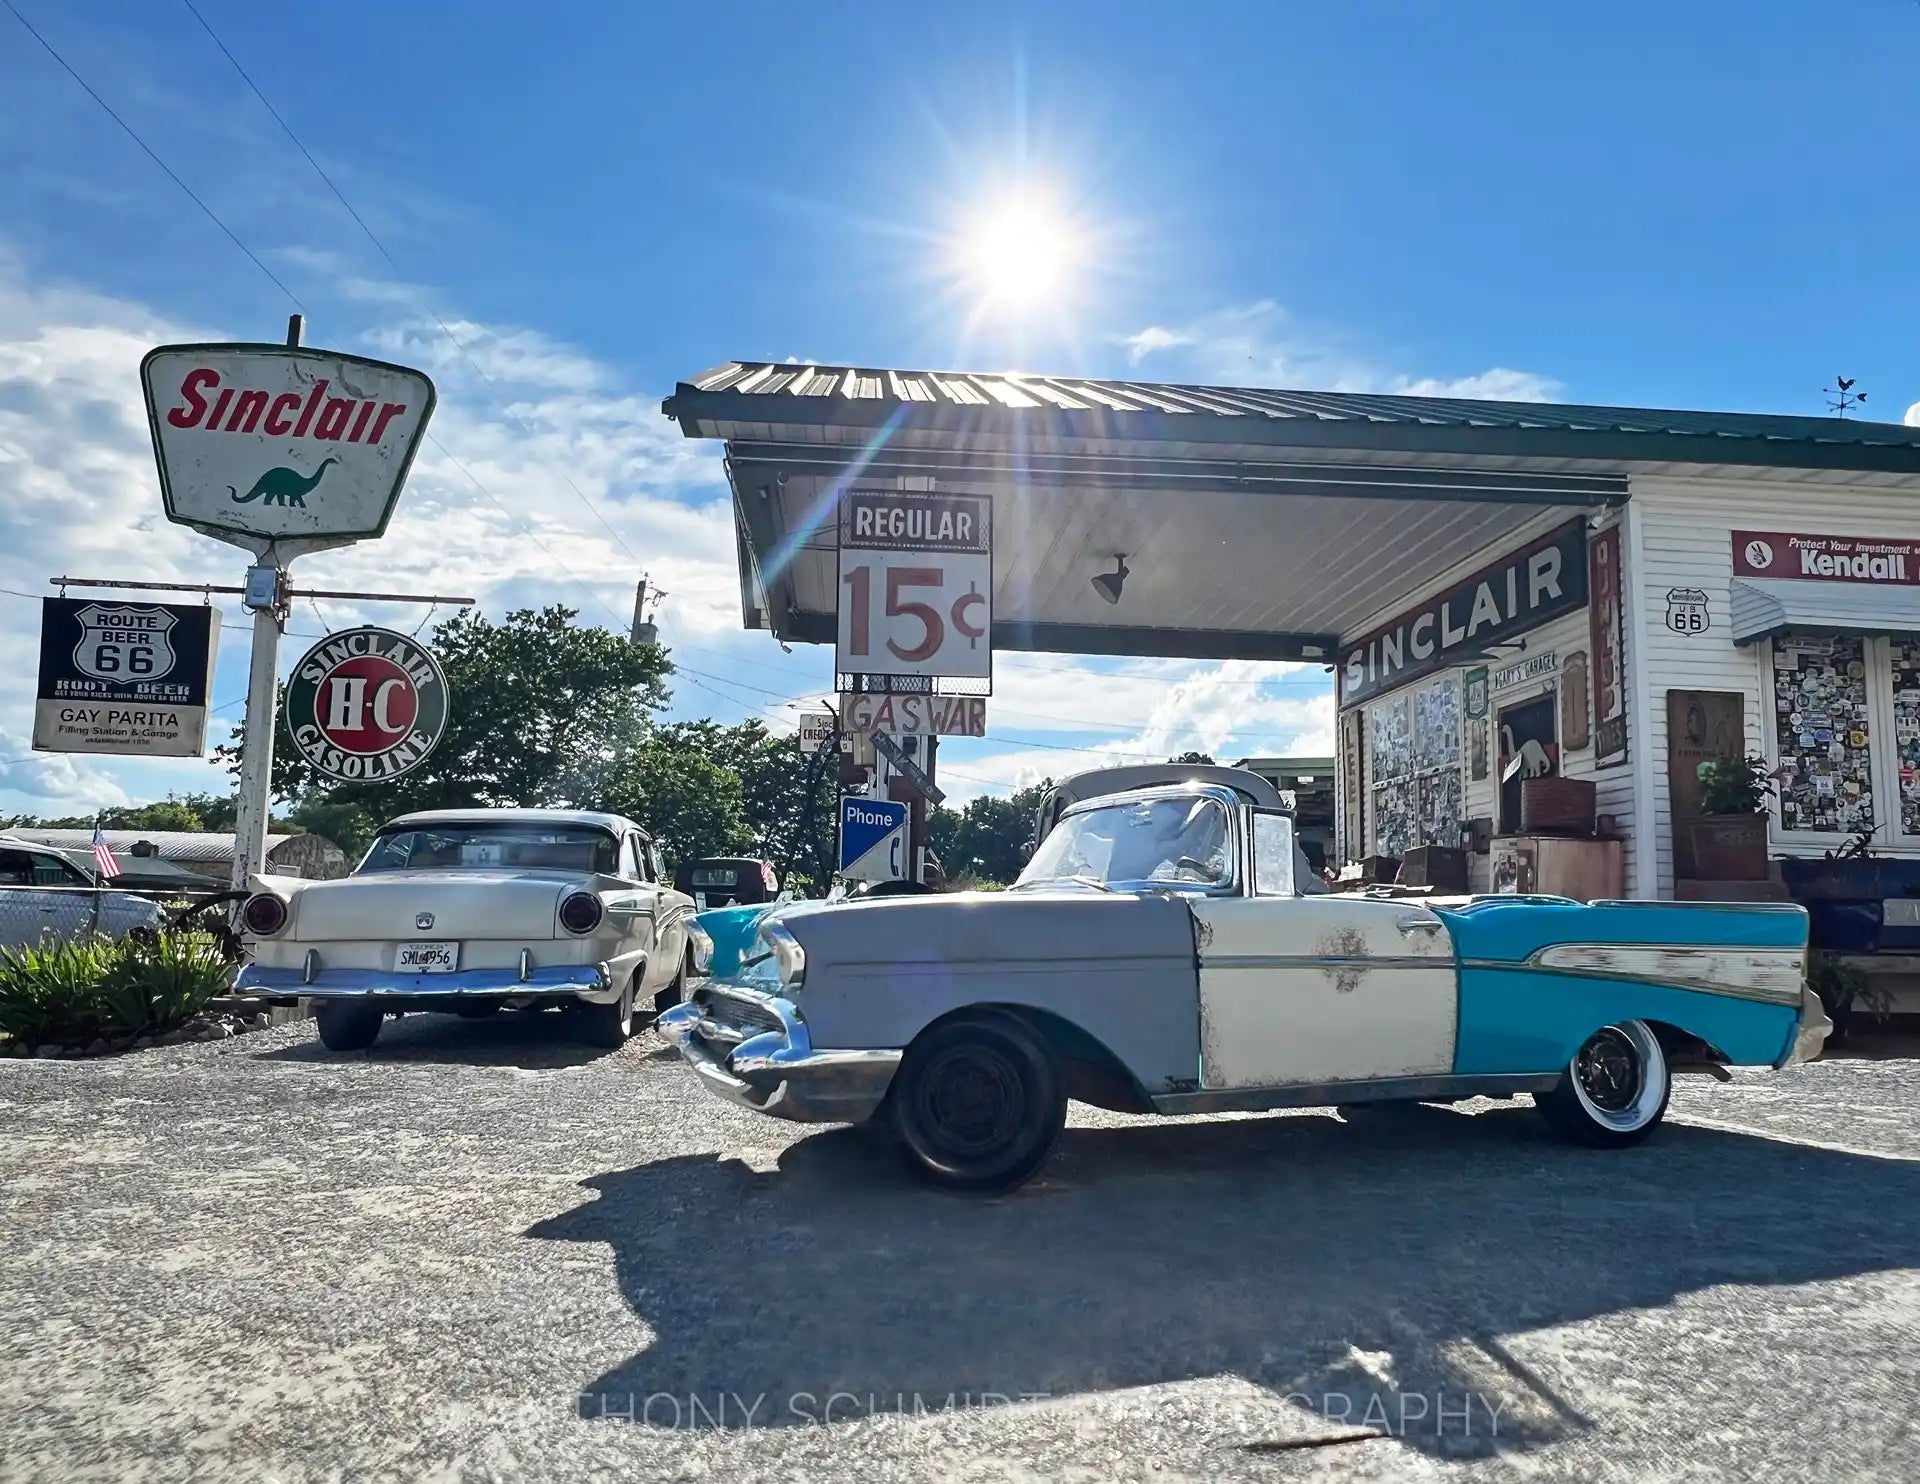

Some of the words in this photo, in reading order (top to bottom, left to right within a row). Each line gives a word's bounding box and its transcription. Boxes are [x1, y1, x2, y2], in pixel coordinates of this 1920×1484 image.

[167, 368, 407, 445] Sinclair
[856, 506, 972, 541] REGULAR
[1788, 537, 1826, 550] Protect
[1830, 540, 1852, 551] Your
[1855, 542, 1911, 555] Investment
[1800, 549, 1905, 580] Kendall
[96, 613, 158, 629] ROUTE
[843, 566, 986, 662] 15¢
[1346, 546, 1563, 692] SINCLAIR
[1675, 613, 1701, 630] 66
[101, 631, 150, 644] BEER
[95, 644, 154, 674] 66
[301, 634, 435, 689] SINCLAIR
[60, 708, 101, 723] GAY
[108, 710, 179, 727] PARITA
[847, 694, 922, 733] GAS
[926, 696, 986, 735] WAR
[58, 725, 89, 736] Filling
[92, 726, 127, 736] Station
[131, 728, 139, 737] &
[142, 728, 178, 740] Garage
[296, 724, 433, 779] GASOLINE
[847, 806, 893, 827] Phone
